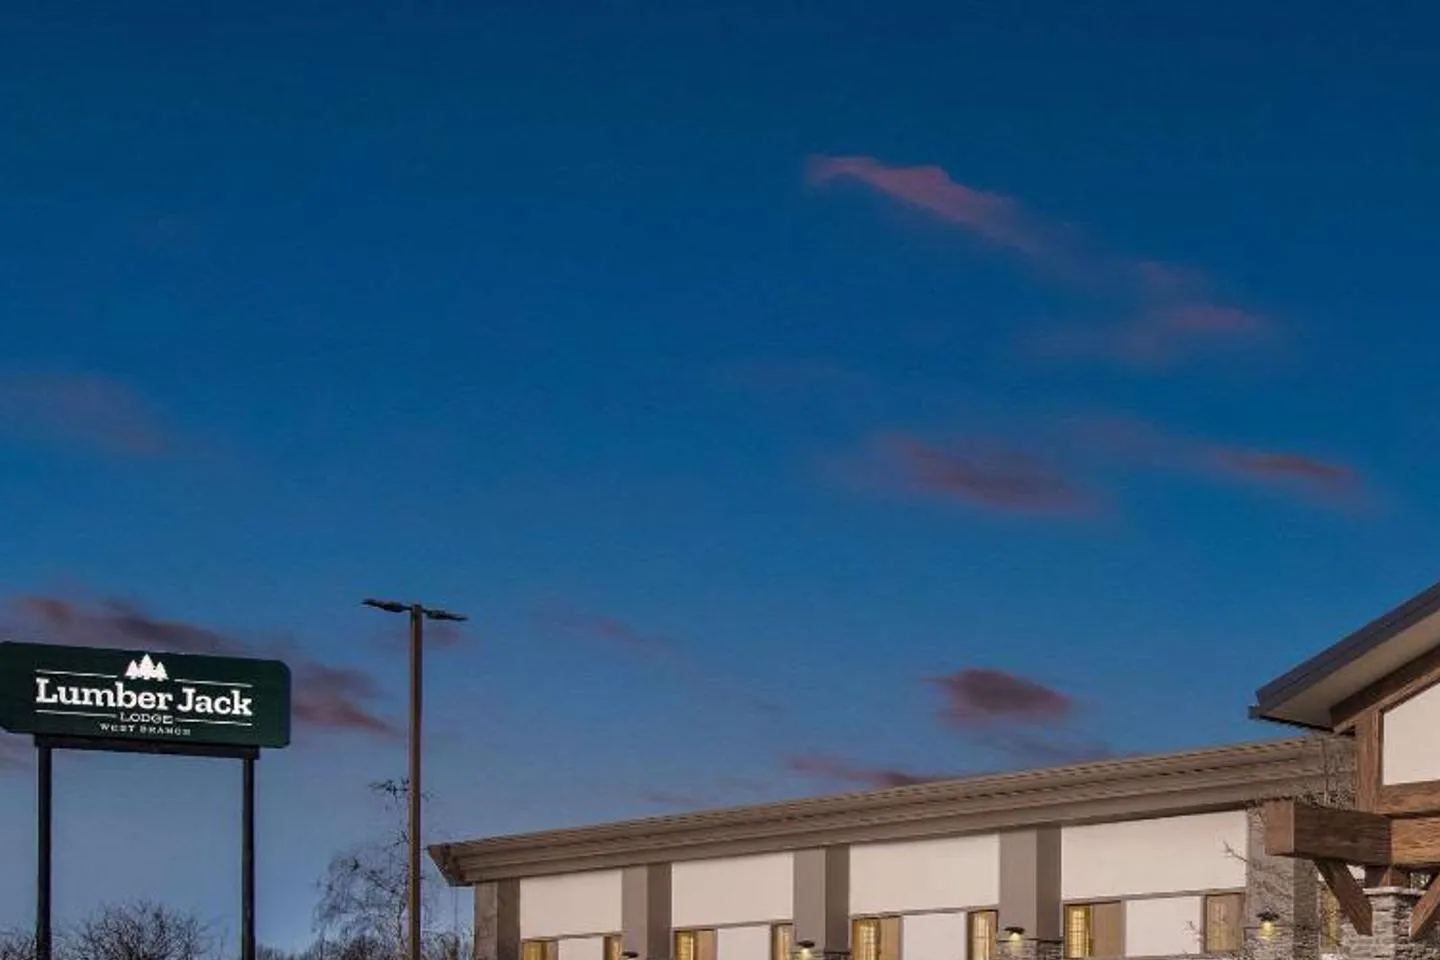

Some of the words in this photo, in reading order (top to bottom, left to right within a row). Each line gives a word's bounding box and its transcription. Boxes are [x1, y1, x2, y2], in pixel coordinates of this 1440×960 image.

[35, 677, 174, 711] Lumber
[176, 687, 253, 717] Jack
[119, 711, 174, 725] LODGE
